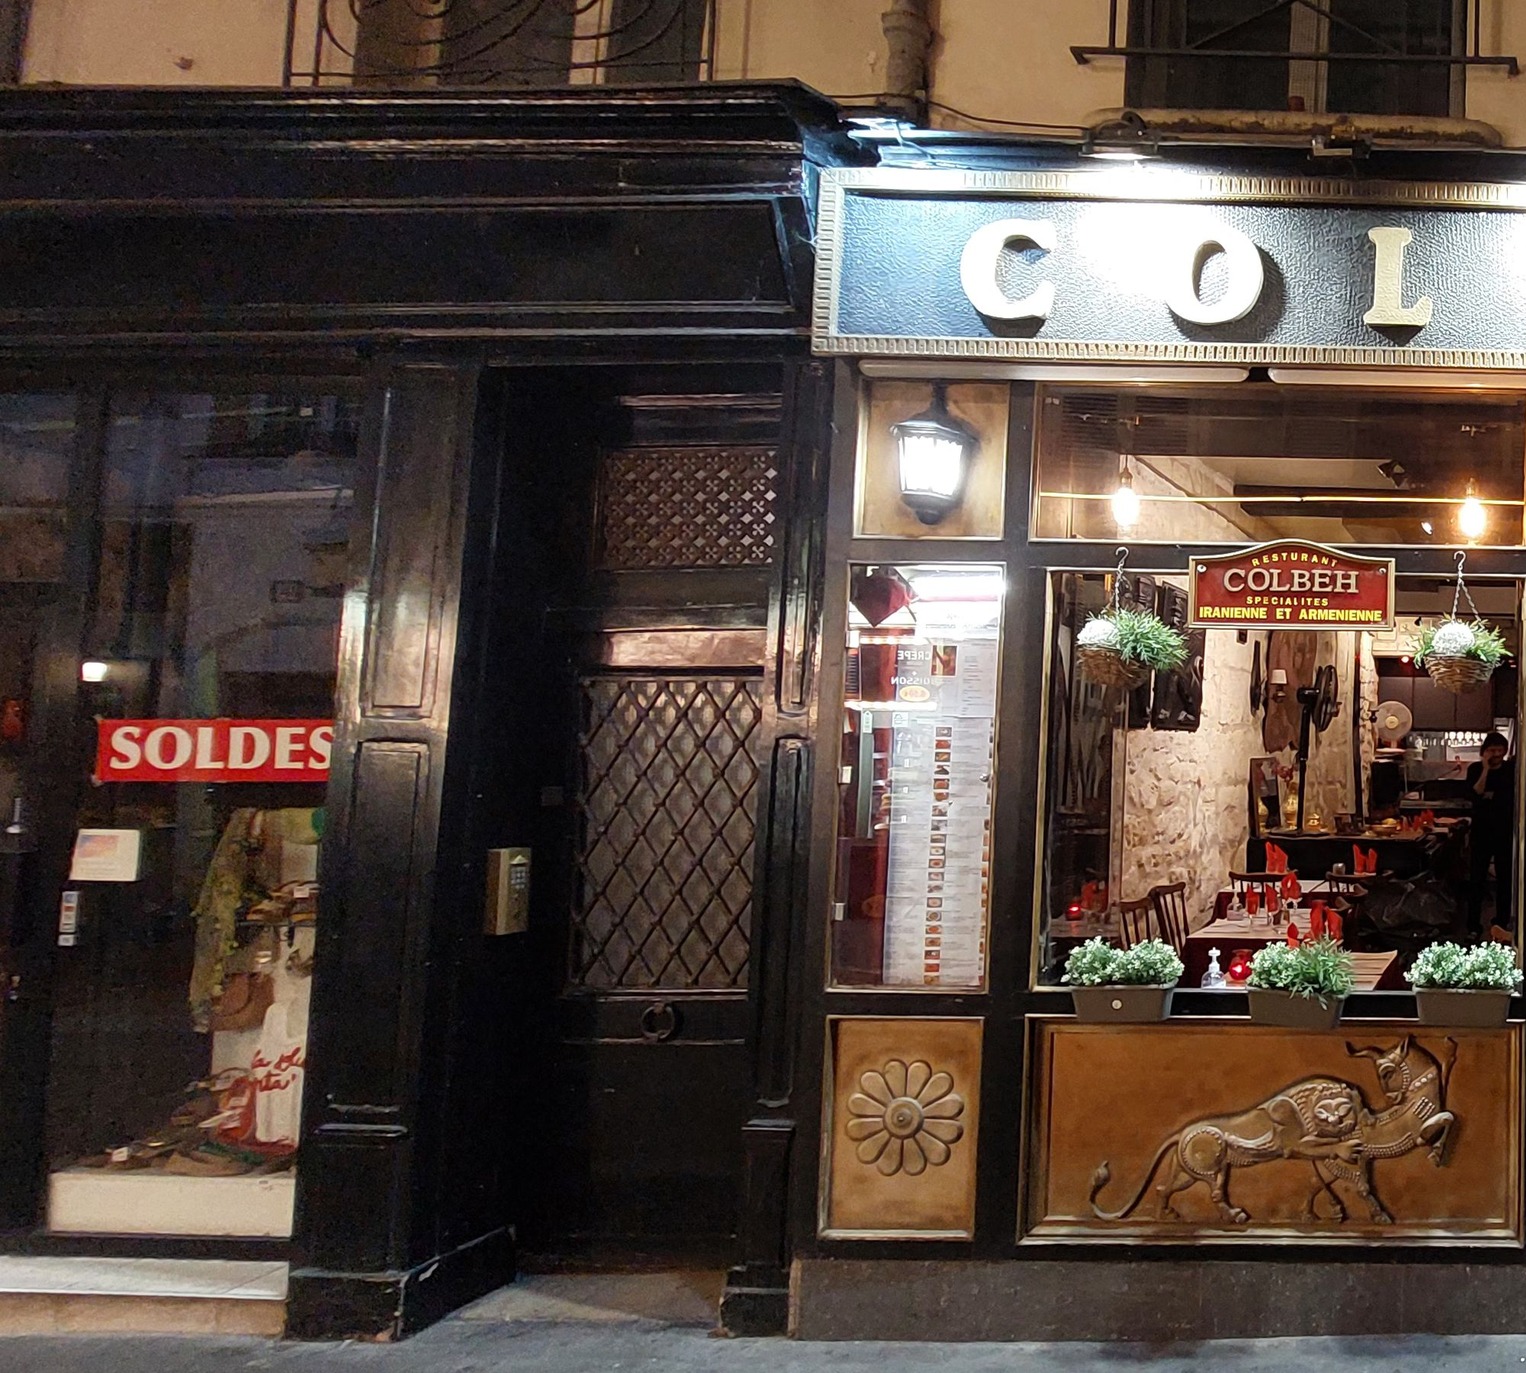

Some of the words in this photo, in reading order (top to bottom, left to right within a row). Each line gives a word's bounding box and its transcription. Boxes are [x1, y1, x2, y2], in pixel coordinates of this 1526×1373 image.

[1251, 552, 1338, 568] RESTURANT
[1223, 568, 1360, 594] COLBEH
[1246, 596, 1329, 607] SPECIALITES
[1199, 606, 1268, 619] IRANIENNE
[1275, 608, 1293, 620] ET
[1299, 609, 1383, 622] ARMENIENNE
[109, 725, 334, 770] SOLDES
